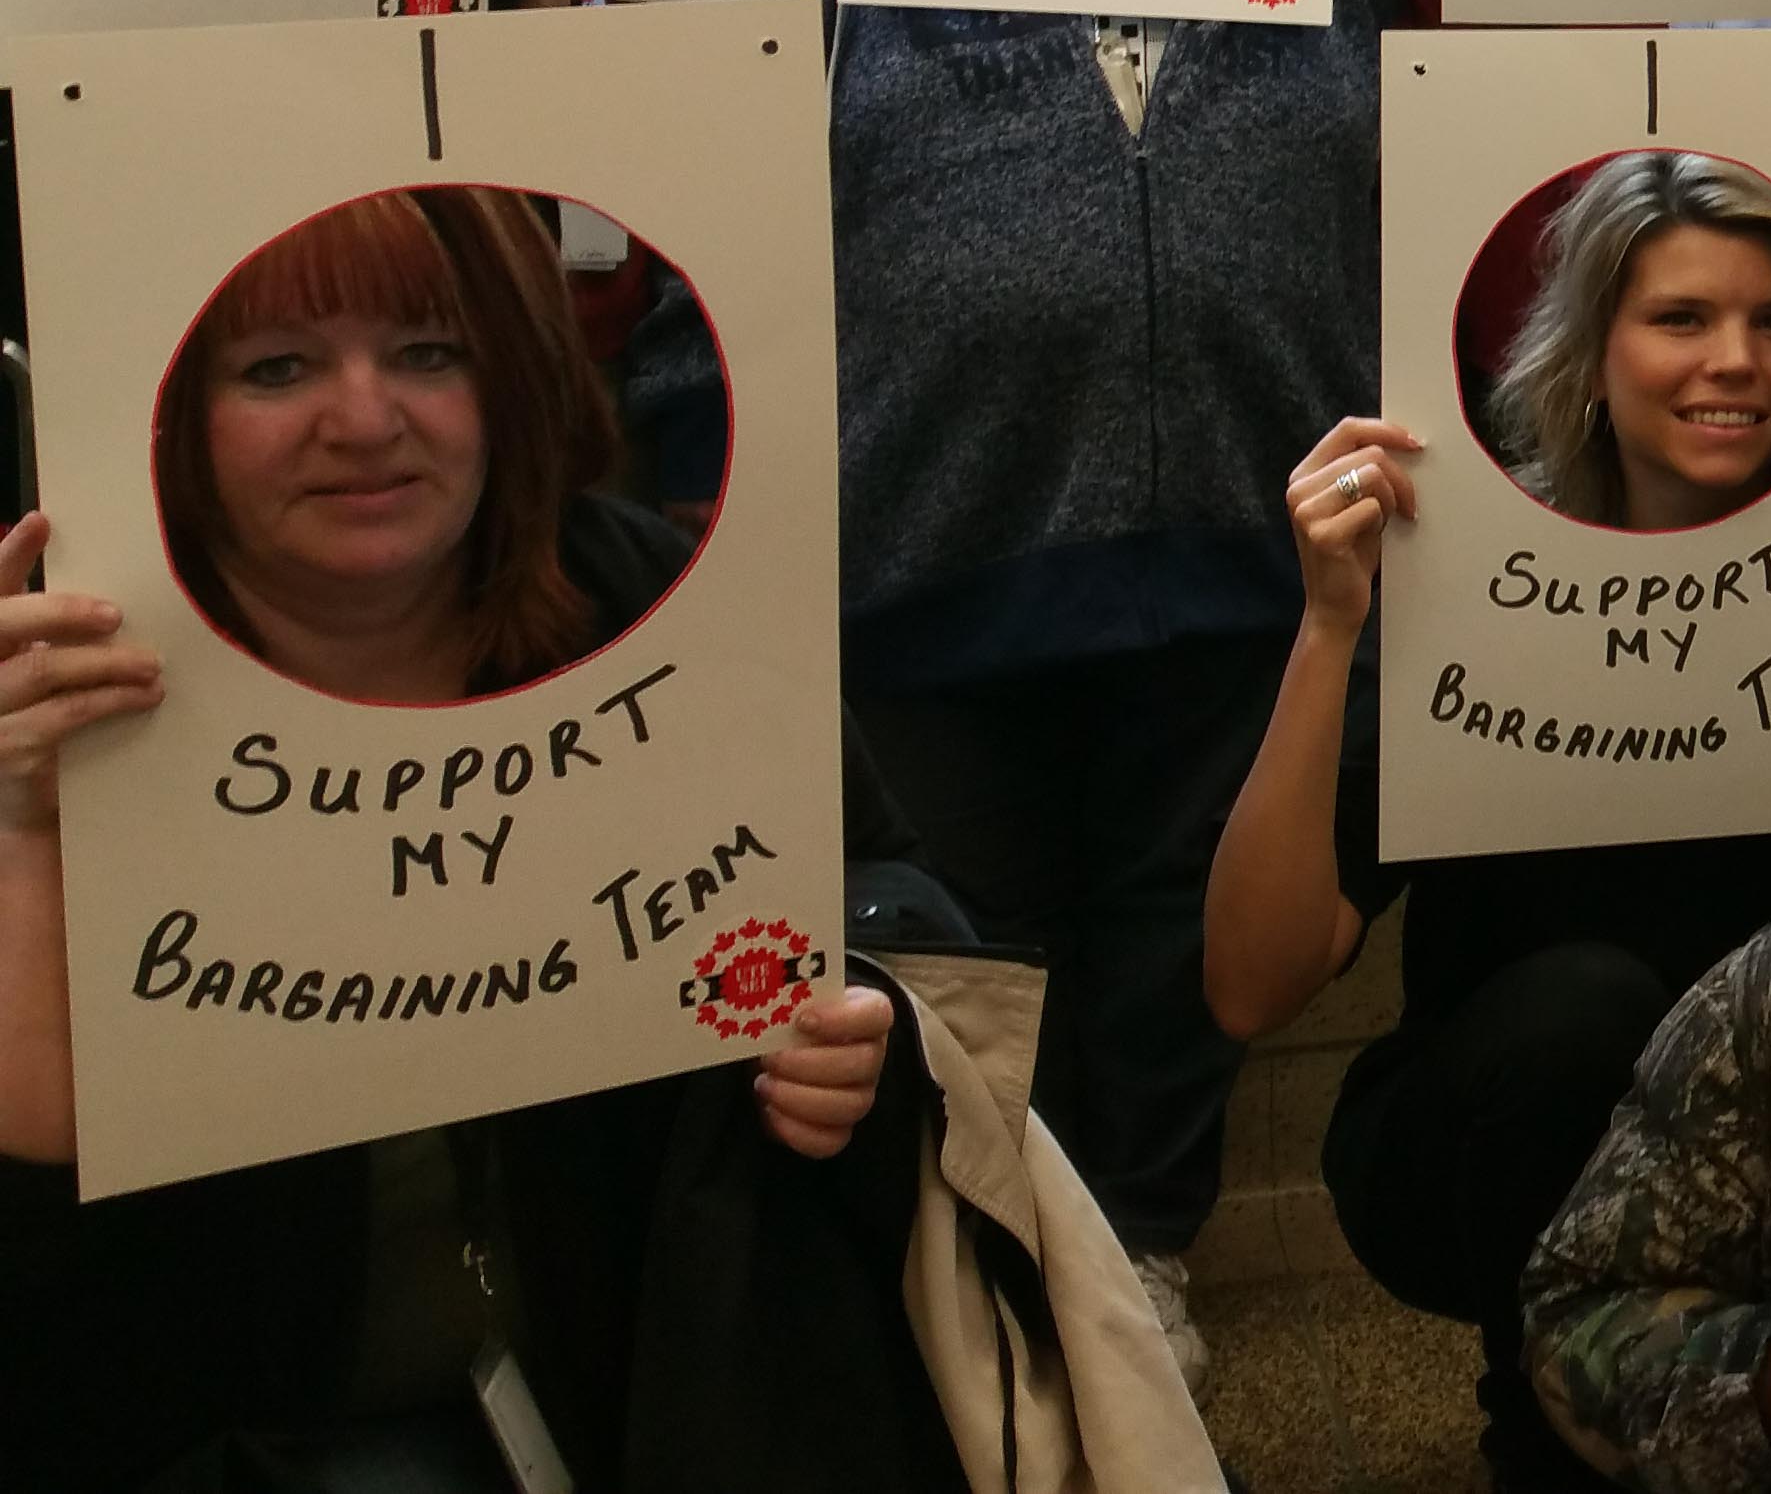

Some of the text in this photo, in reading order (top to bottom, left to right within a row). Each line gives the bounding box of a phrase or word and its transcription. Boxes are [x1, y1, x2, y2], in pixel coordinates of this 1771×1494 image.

[1605, 621, 1698, 673] MY
[214, 663, 678, 816] SUPPORT
[1429, 662, 1727, 764] BARGAINING
[391, 816, 514, 897] MY
[132, 824, 778, 1023] BARGAINING TEAM
